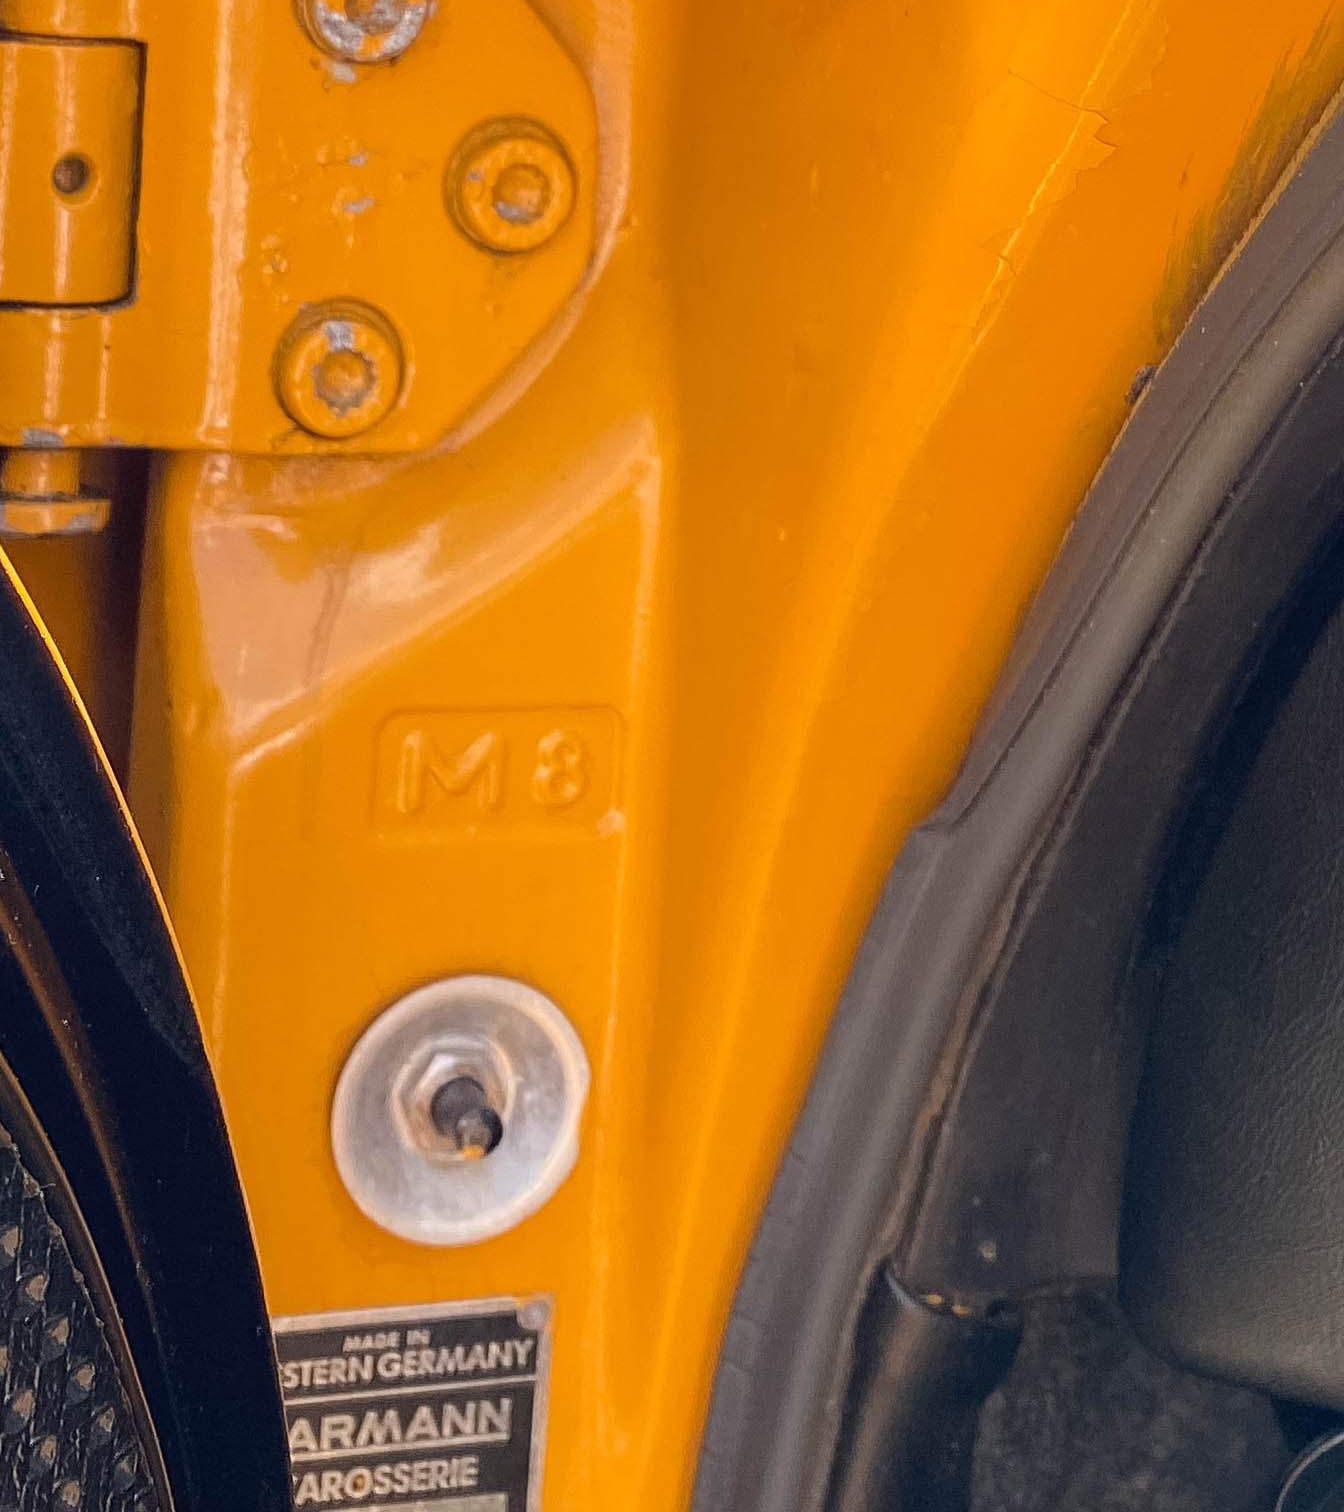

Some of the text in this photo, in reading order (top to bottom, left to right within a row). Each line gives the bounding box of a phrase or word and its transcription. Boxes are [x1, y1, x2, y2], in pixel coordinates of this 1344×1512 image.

[280, 1339, 534, 1389] STERN GERMANY
[343, 1329, 431, 1352] MADE IN
[287, 1397, 512, 1452] ARMANN
[291, 1456, 479, 1506] AROSSERIE
